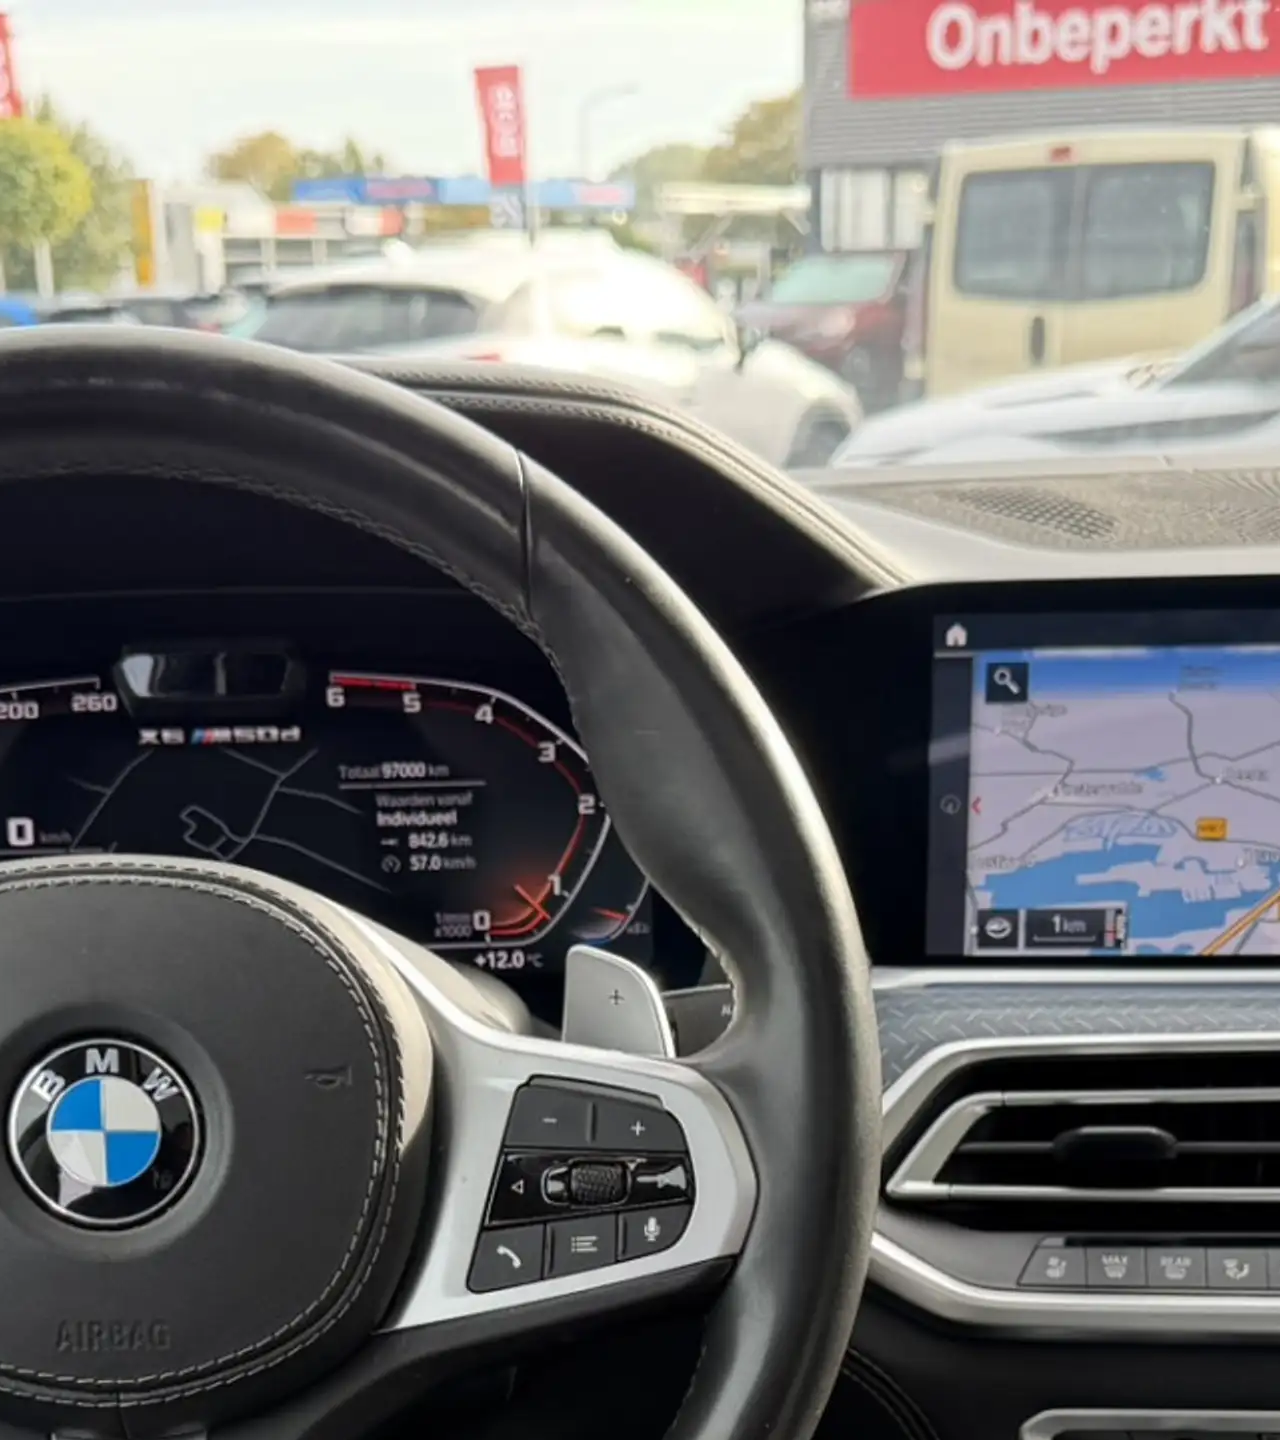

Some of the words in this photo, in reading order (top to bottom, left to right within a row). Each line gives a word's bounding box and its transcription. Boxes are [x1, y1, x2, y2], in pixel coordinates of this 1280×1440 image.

[924, 0, 1269, 74] Onbeperkt
[71, 693, 118, 712] 260
[326, 686, 345, 708] 6
[403, 694, 421, 713] 5
[475, 705, 494, 724] 4
[538, 742, 556, 762] 3
[381, 762, 426, 779] 97000
[428, 763, 450, 777] km
[577, 795, 596, 815] 2
[376, 811, 458, 827] Individueel
[6, 818, 35, 847] 0
[408, 833, 449, 848] 842.6
[450, 832, 473, 847] km
[409, 856, 442, 872] 57.0
[547, 874, 562, 896] 1
[473, 910, 490, 931] 0
[1051, 914, 1061, 932] 1
[1062, 915, 1087, 932] km
[473, 950, 525, 969] +12.0
[30, 1048, 181, 1102] BMW
[54, 1317, 171, 1352] AIRBAG
